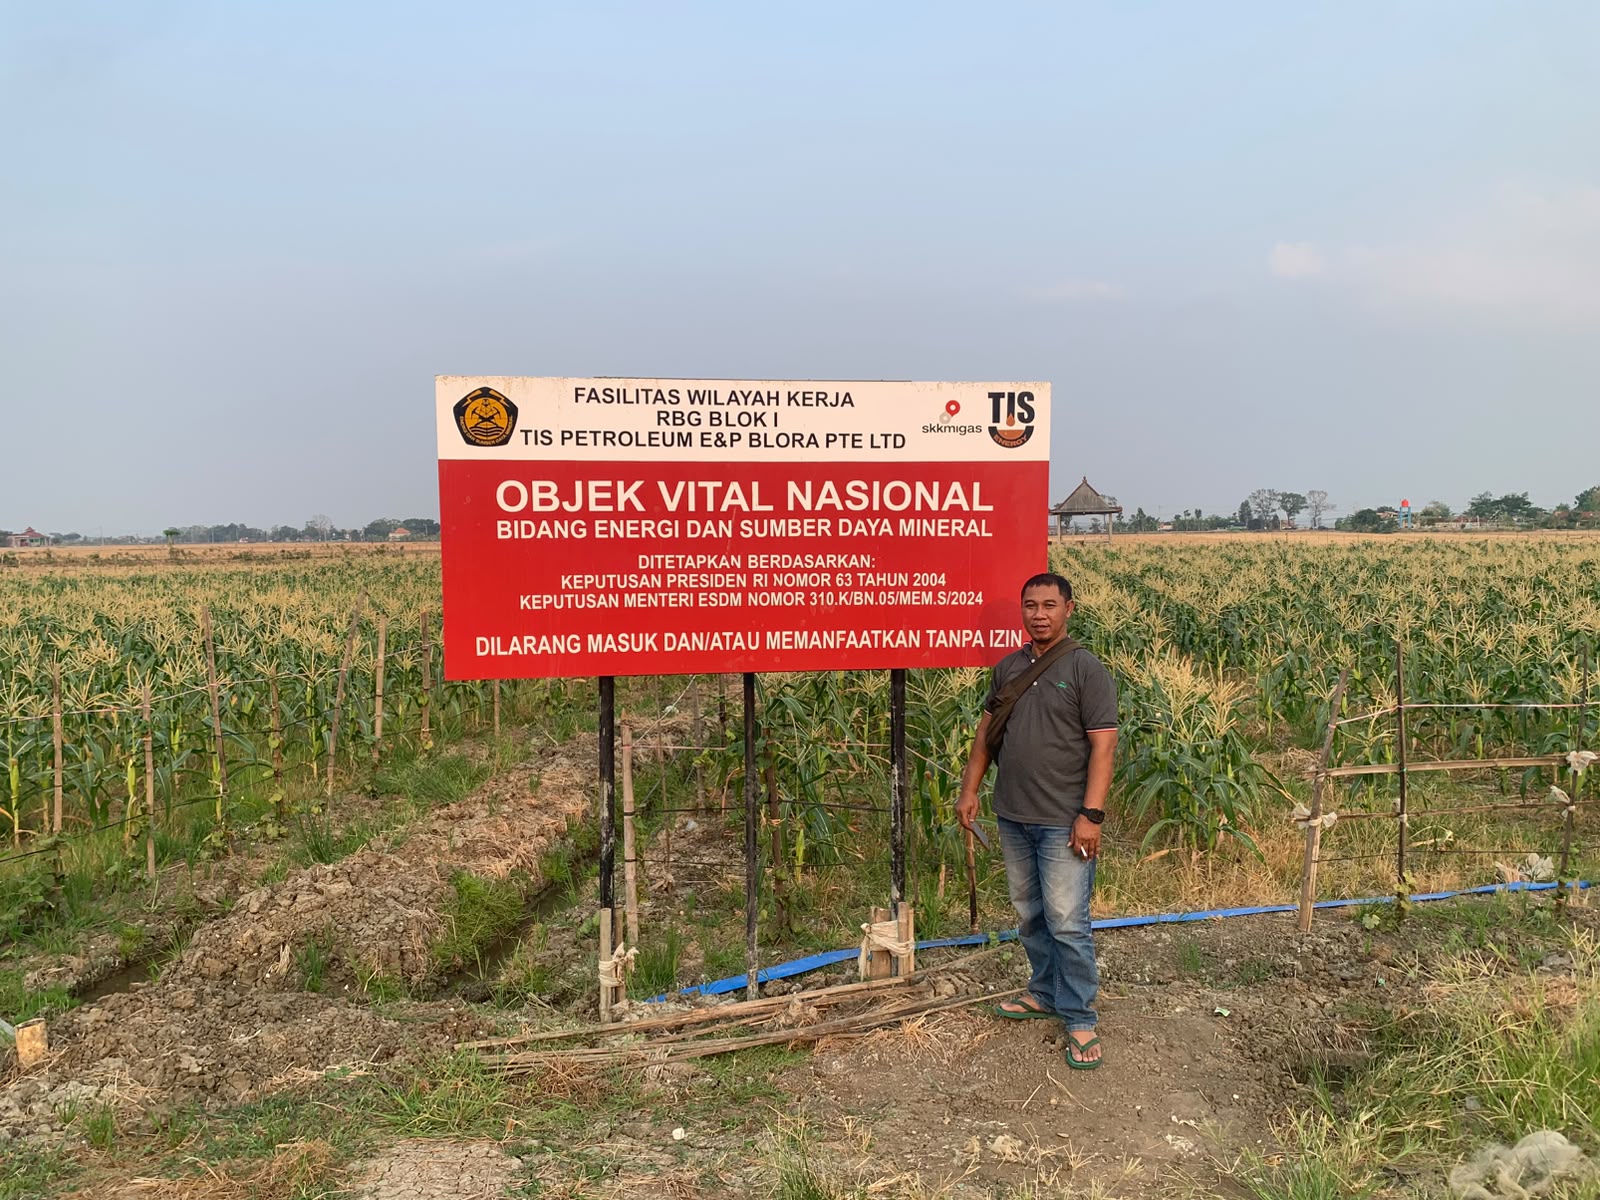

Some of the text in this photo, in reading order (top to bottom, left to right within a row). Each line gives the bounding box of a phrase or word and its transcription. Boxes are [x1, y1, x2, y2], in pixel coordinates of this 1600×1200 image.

[575, 388, 854, 407] FASILITAS WILAYAH KERJA
[988, 391, 1035, 424] TIS
[657, 411, 778, 427] RBG BLOK I
[922, 423, 982, 436] skkmigas
[520, 430, 905, 449] TIS PETROLEUM E&P BLORA PTE LTD
[993, 433, 1028, 448] ENERGY
[496, 480, 993, 512] OBJEK VITAL NASIONAL
[497, 519, 992, 539] BIDANG ENERGI DAN SUMBER DAYA MINERAL
[638, 554, 876, 569] DITETAPKAN BERDASARKAN:
[561, 573, 946, 589] KEPUTUSAN PRESIDEN RI NOMOR 63 TAHUN 2004
[520, 591, 983, 609] KEPUTUSAN MENTERI ESDM NOMOR 310.K/BN.05/MEM.S/2024
[476, 630, 1022, 656] DILARANG MASUK DAN/ATAU MEMANFAATKAN TANPA IZIN
